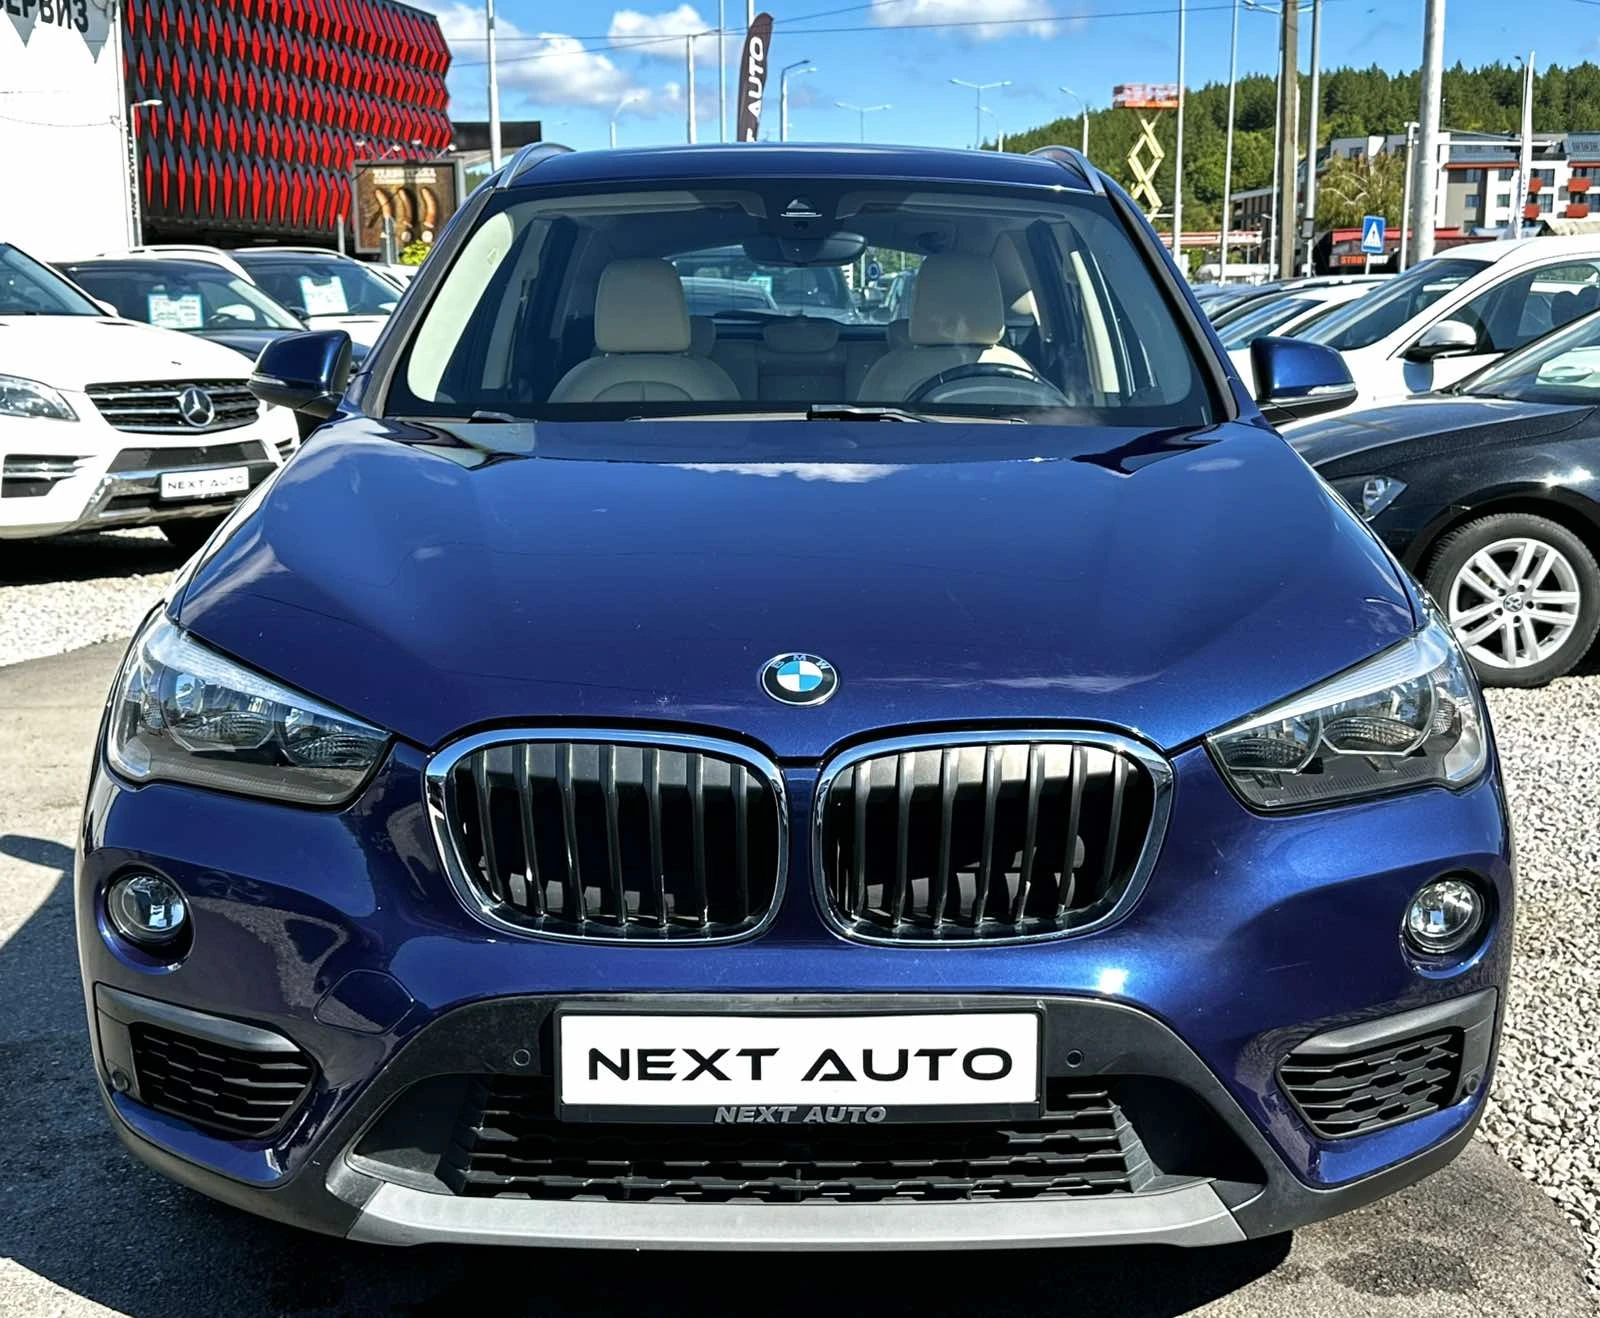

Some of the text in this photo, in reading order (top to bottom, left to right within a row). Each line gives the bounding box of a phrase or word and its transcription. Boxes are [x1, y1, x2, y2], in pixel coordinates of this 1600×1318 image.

[747, 36, 764, 119] AUTO
[168, 476, 244, 489] NEXT AUTO
[588, 1047, 1013, 1081] NEXT AUTO
[714, 1105, 887, 1124] NEXT AUTO
